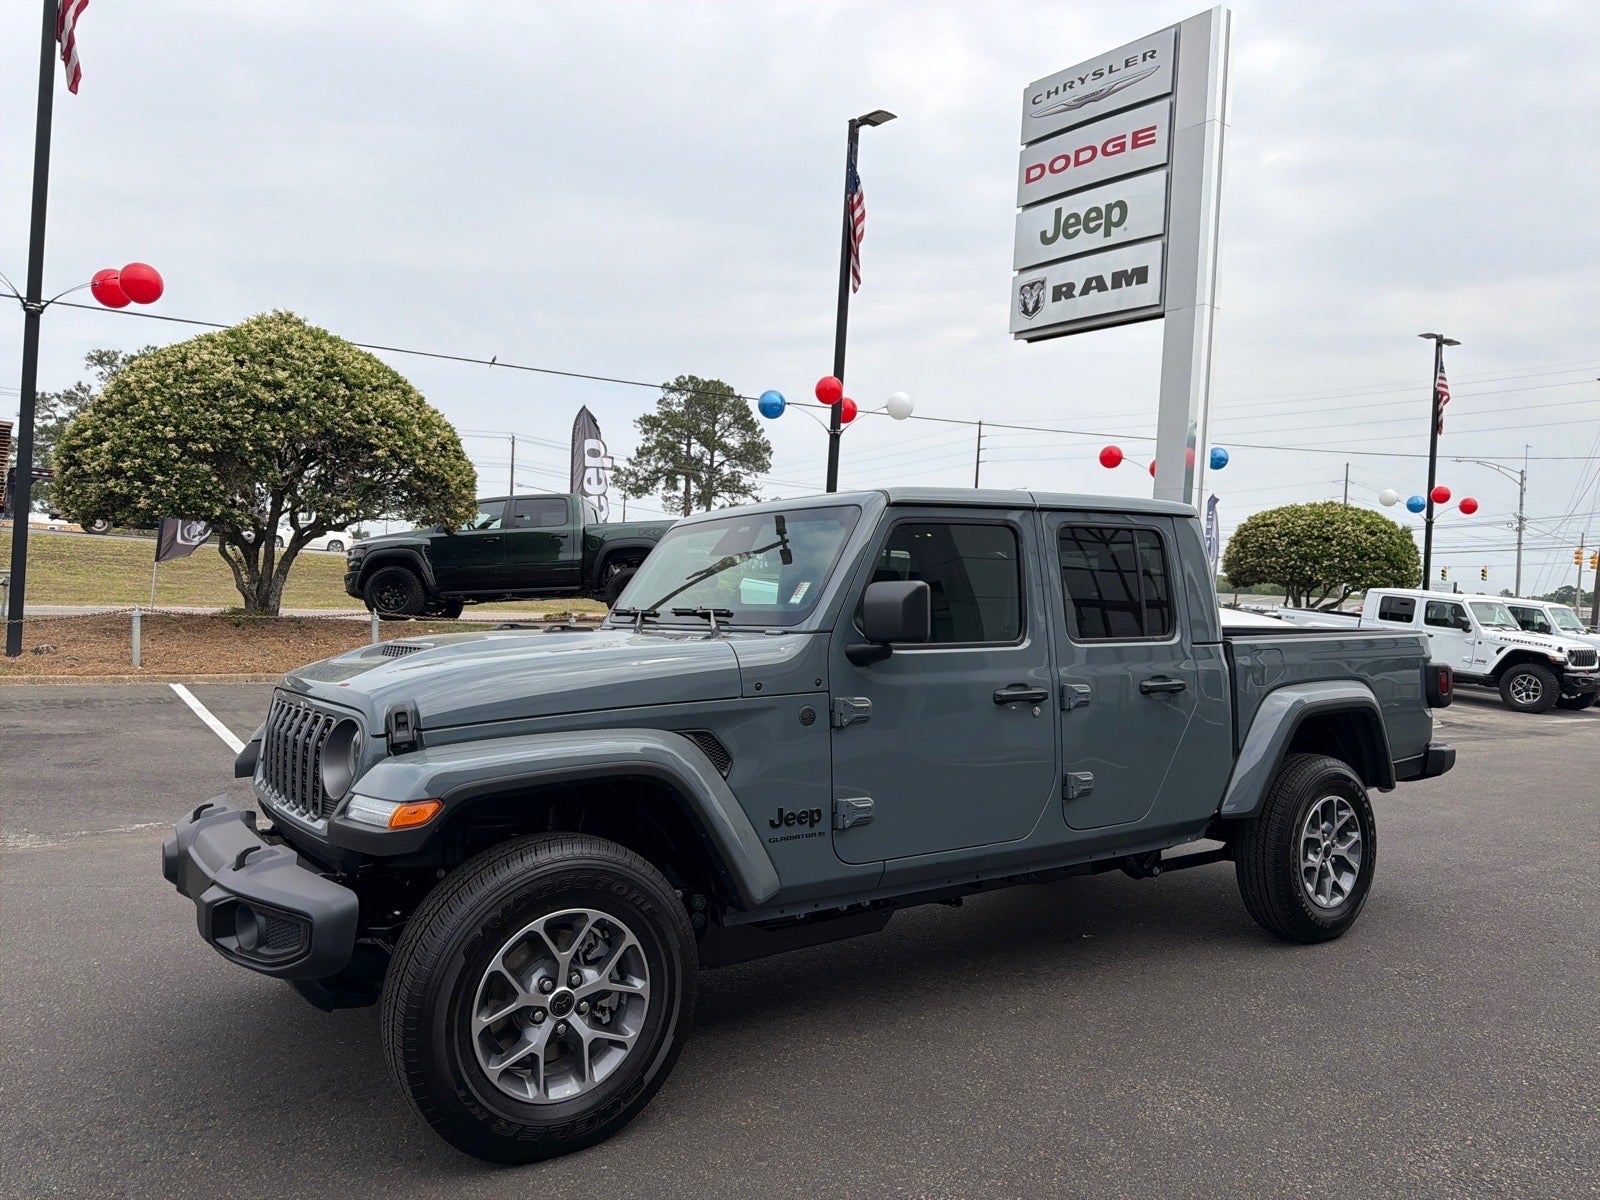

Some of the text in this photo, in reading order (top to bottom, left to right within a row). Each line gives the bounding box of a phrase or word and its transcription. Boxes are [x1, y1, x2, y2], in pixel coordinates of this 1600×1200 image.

[1031, 49, 1158, 106] CHRYSLER
[1025, 125, 1157, 185] DODGE
[1040, 199, 1128, 246] Jeep
[1052, 265, 1149, 303] RAM
[584, 438, 613, 523] eep
[1499, 636, 1553, 648] RUBICON
[769, 807, 822, 829] Jeep
[769, 832, 817, 844] GLADIATOR
